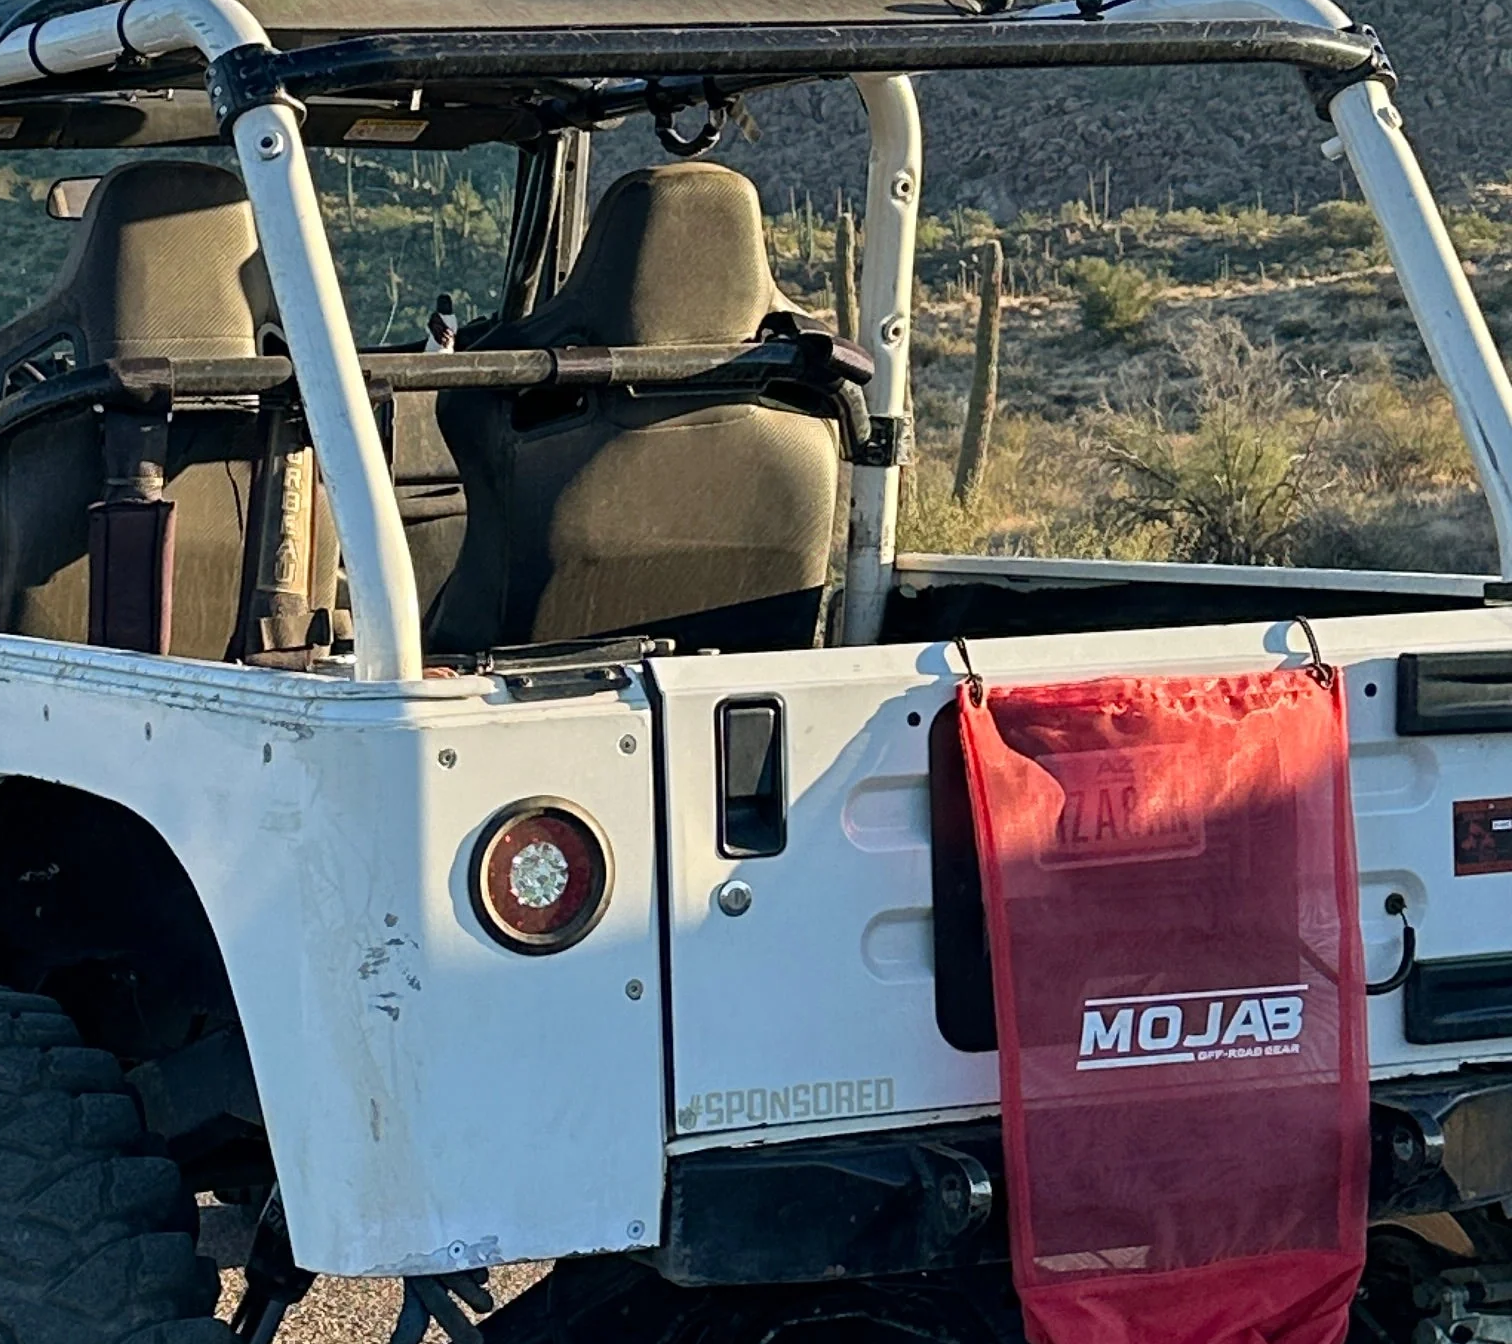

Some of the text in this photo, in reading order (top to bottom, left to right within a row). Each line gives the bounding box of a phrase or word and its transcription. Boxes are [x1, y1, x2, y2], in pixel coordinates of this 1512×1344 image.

[1079, 996, 1304, 1056] MOJAB
[1197, 1043, 1300, 1061] OFF-ROAD GEAR
[690, 1077, 894, 1125] #SPONSORED
